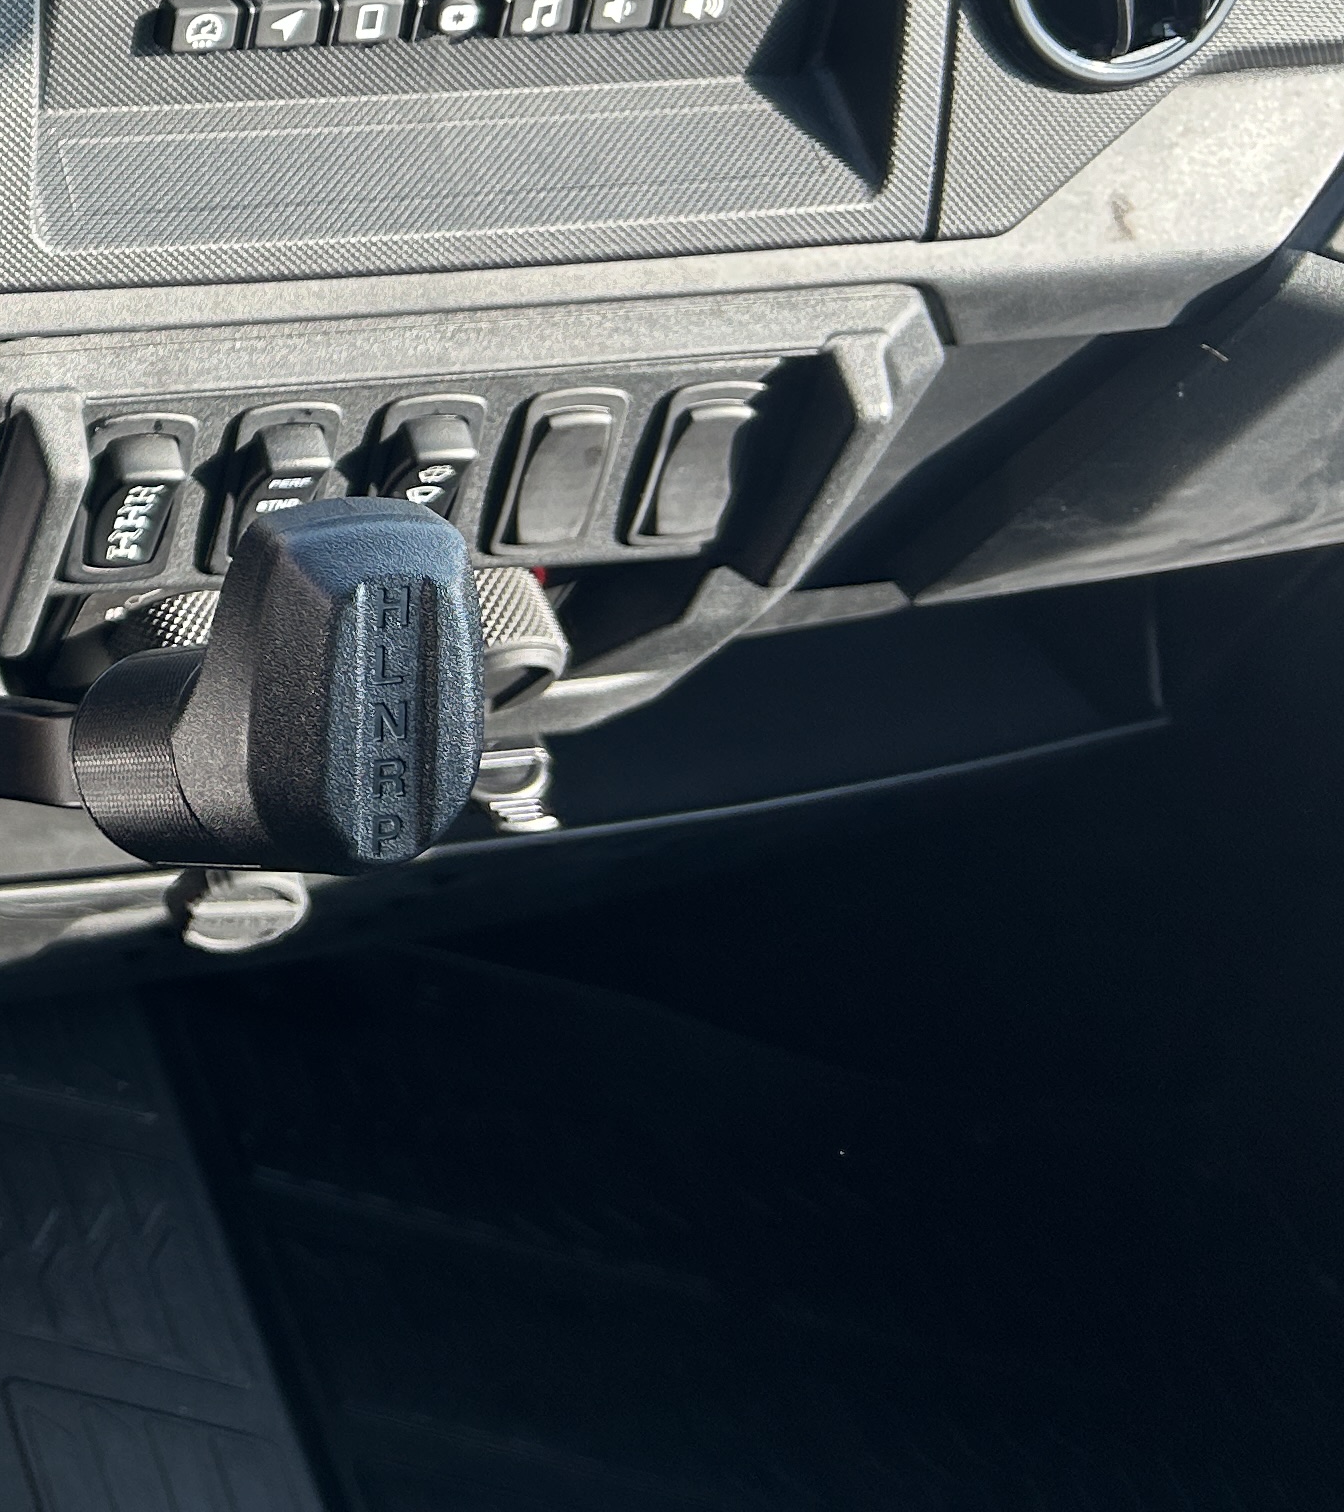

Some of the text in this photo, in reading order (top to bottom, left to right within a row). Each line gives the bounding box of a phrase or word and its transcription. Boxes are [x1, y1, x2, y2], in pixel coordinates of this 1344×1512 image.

[268, 476, 313, 490] PERF
[371, 584, 411, 858] H L N R P
